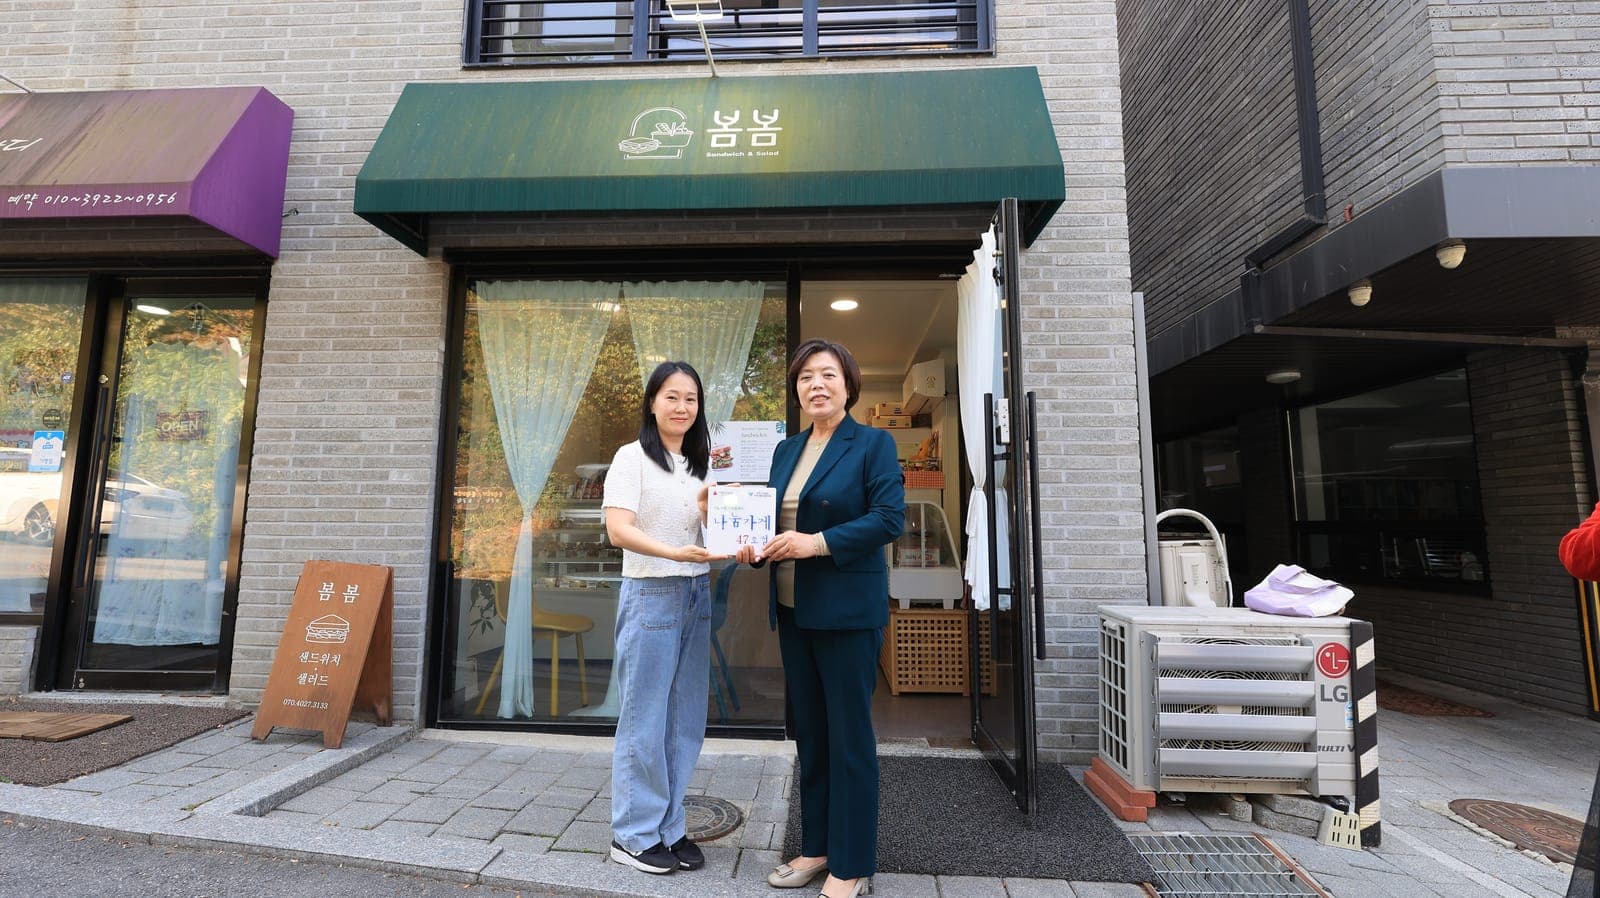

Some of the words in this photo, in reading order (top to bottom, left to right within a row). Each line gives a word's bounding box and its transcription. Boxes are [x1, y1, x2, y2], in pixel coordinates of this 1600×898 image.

[706, 109, 783, 148] 봄봄
[714, 512, 771, 531] 나눔가게
[299, 651, 341, 667] 샌드위치
[1320, 684, 1349, 703] LG
